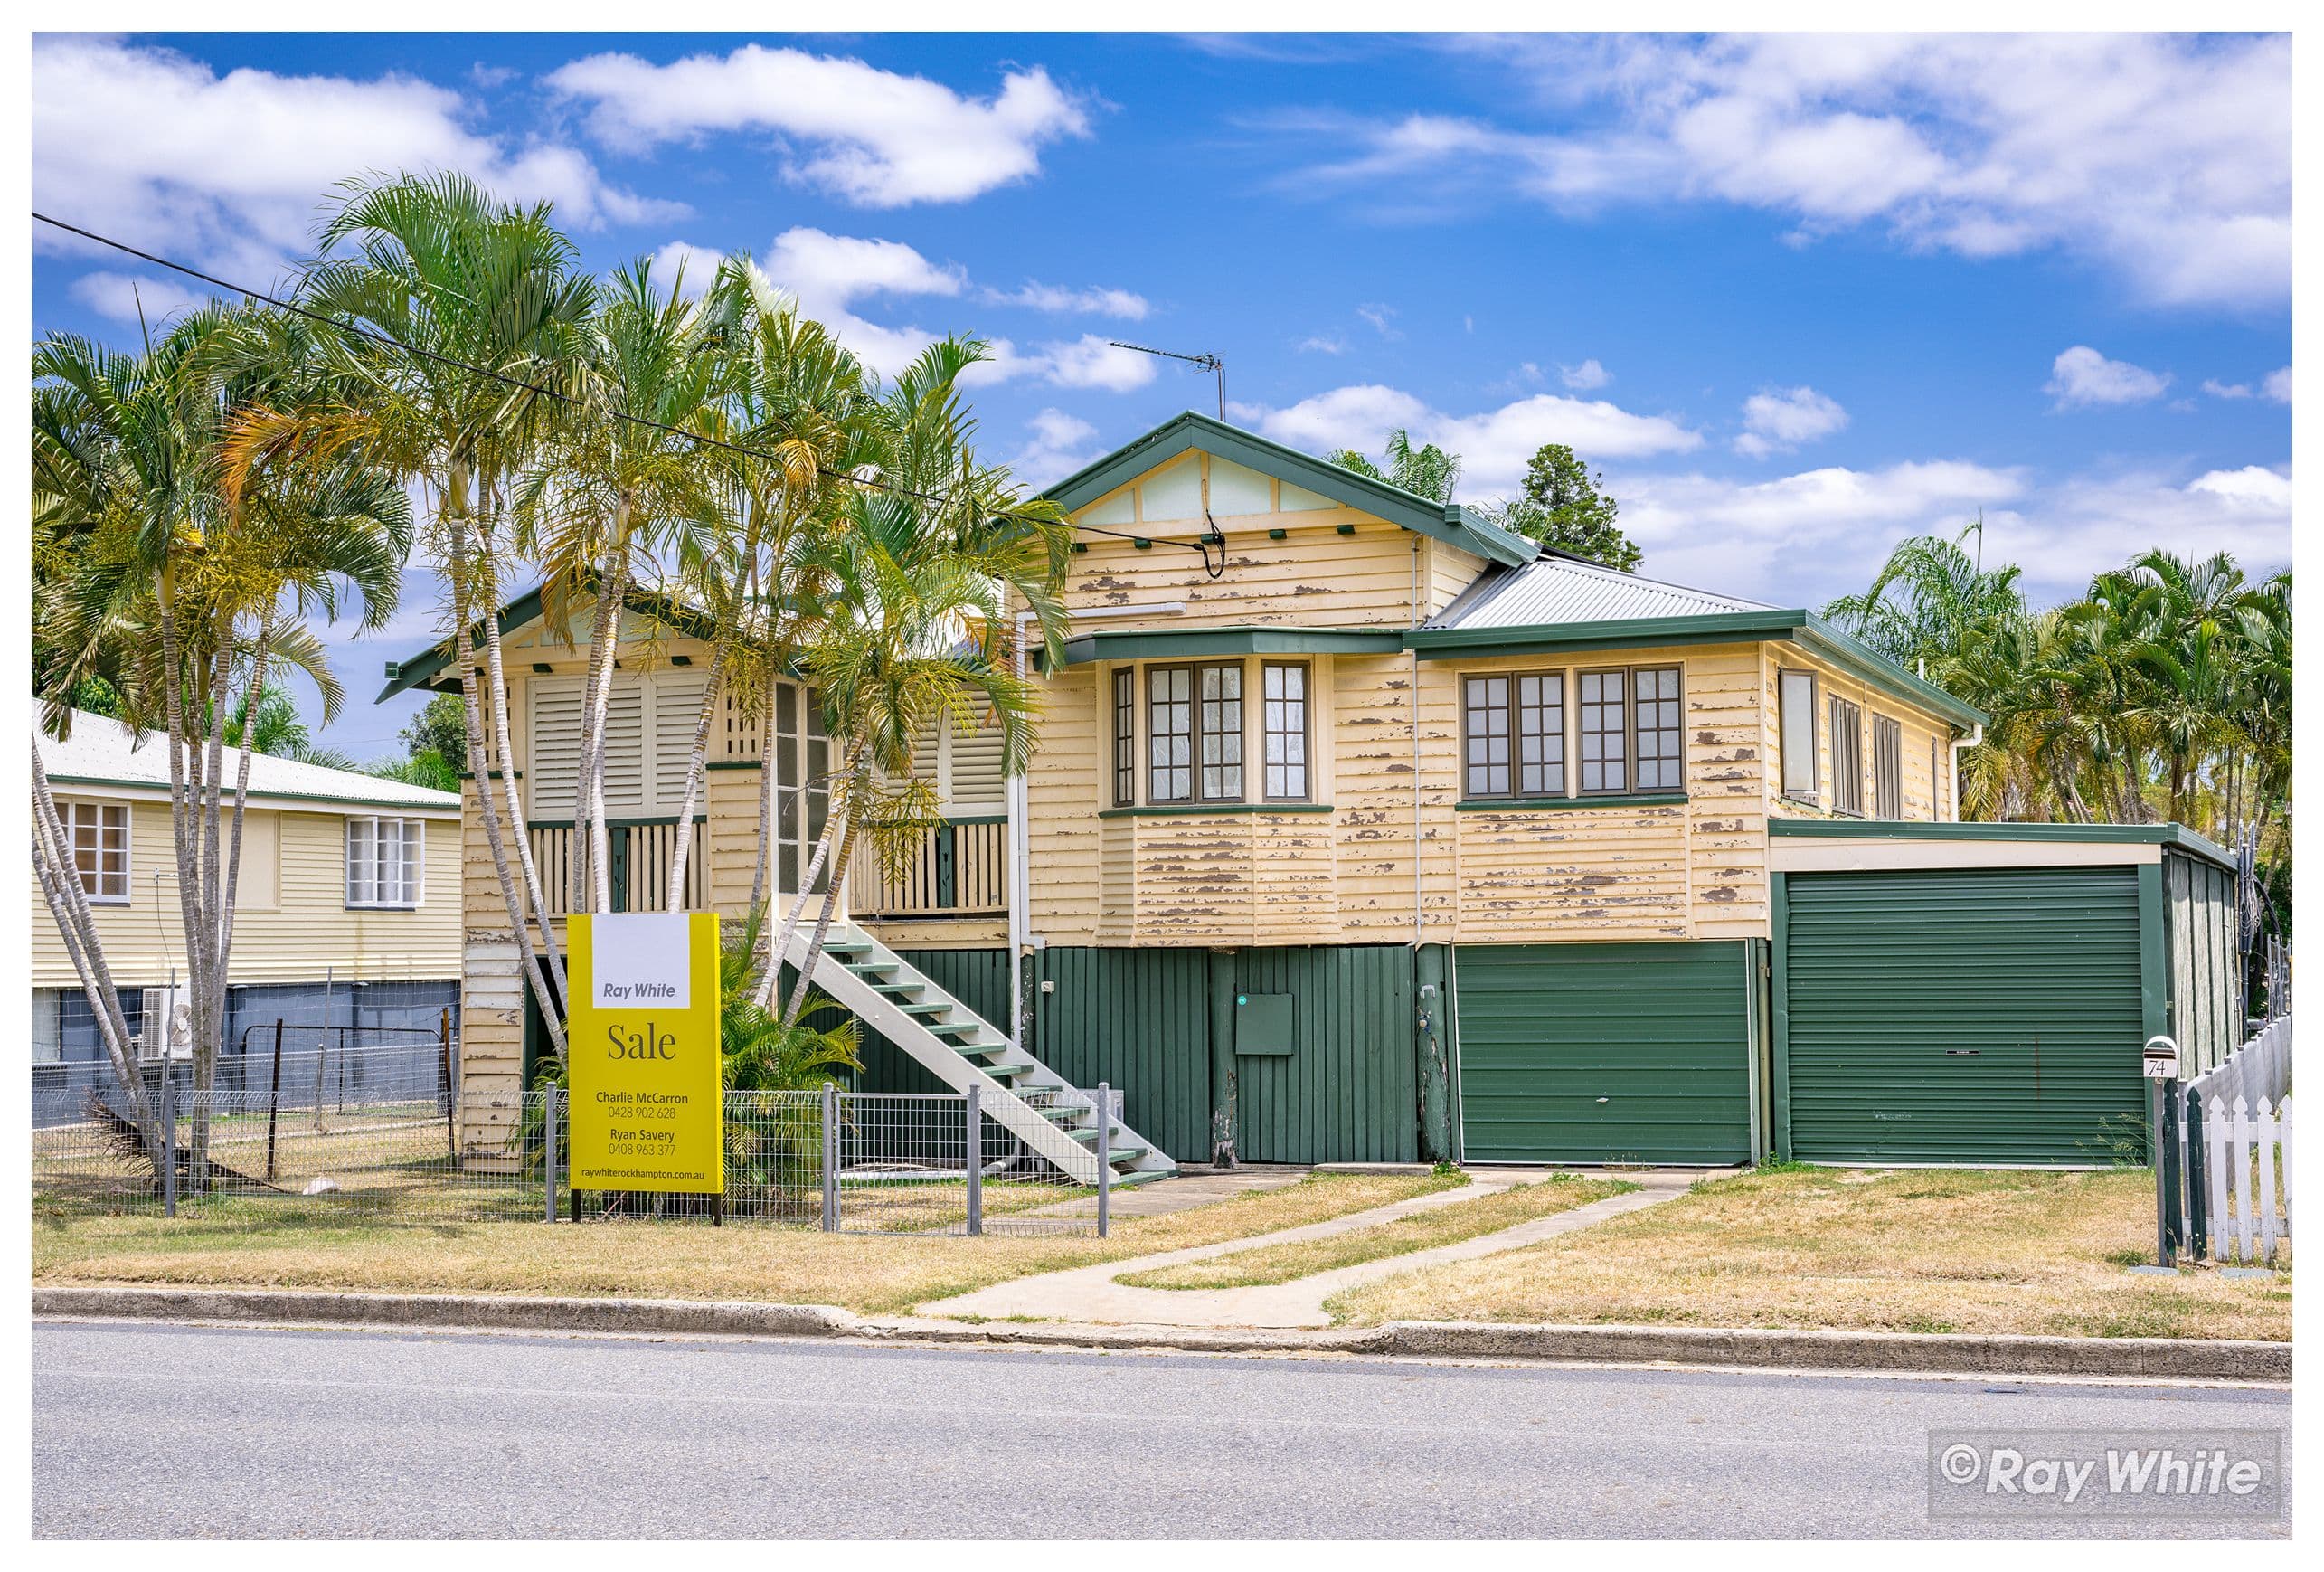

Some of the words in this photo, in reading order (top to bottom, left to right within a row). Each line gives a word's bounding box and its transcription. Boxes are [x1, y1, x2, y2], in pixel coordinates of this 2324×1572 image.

[603, 983, 632, 1000] Ray
[634, 983, 675, 998] White
[608, 1022, 676, 1060] Sale
[2149, 1060, 2166, 1075] 74
[596, 1091, 633, 1103] Charlie
[636, 1092, 688, 1104] McCarron
[608, 1106, 633, 1118] 0428
[636, 1107, 654, 1119] 902
[657, 1107, 676, 1119] 628
[610, 1129, 636, 1142] Ryan
[639, 1130, 675, 1143] Savery
[609, 1143, 633, 1155] 0408
[636, 1143, 655, 1156] 963
[657, 1144, 675, 1156] 377
[581, 1168, 704, 1180] raywhiterockhampton.com.au
